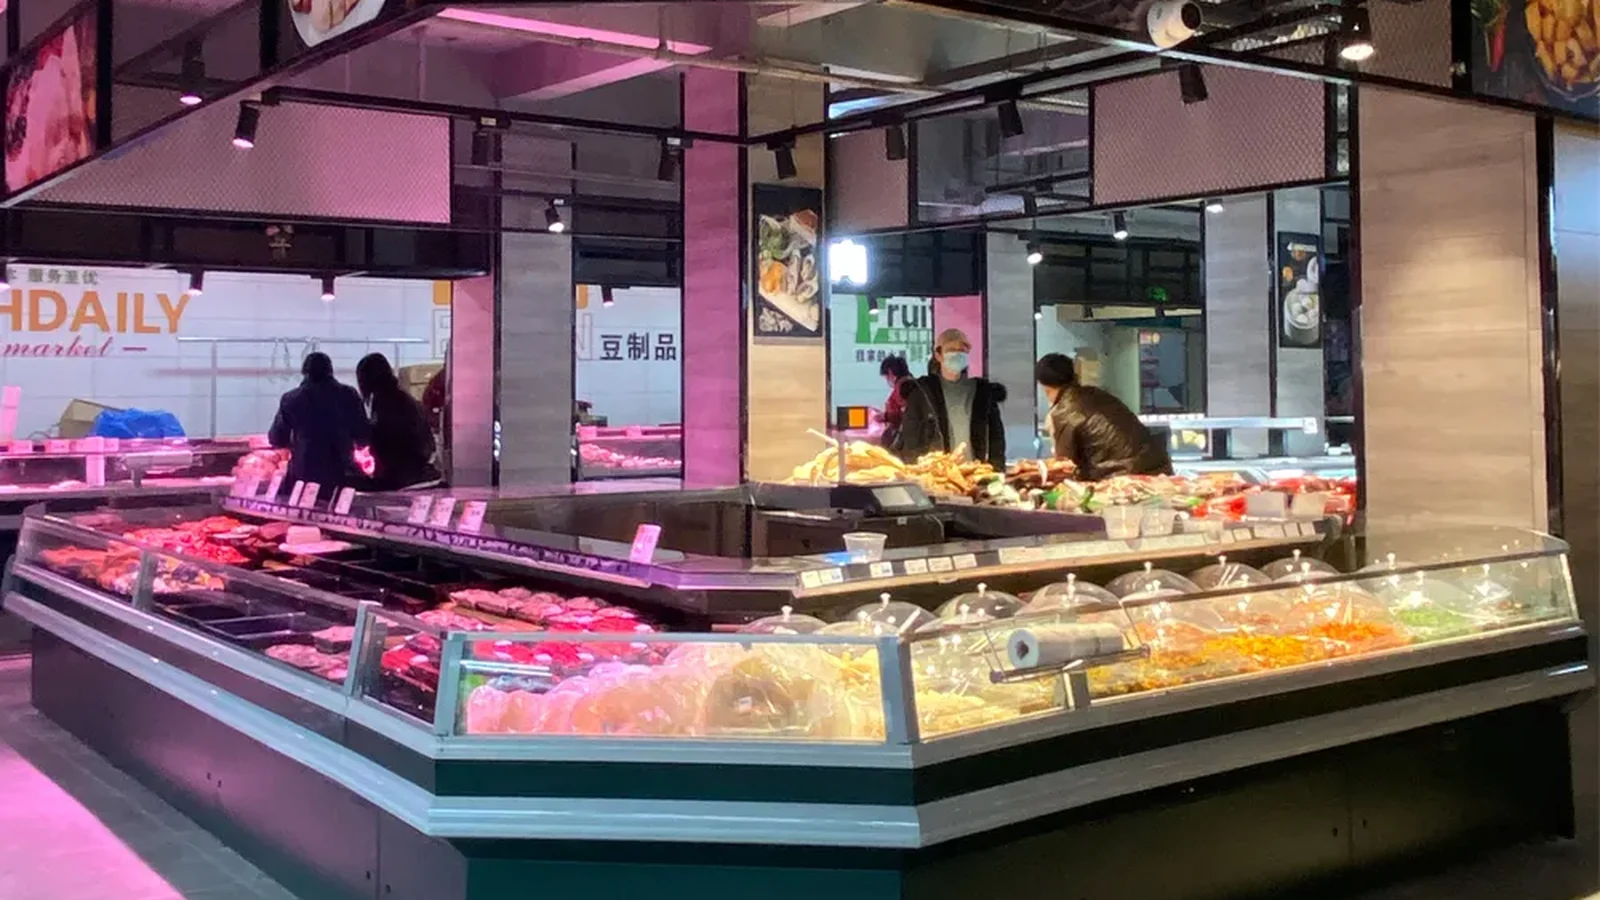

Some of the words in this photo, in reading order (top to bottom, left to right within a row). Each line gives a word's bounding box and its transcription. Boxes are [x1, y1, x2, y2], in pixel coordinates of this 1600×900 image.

[855, 294, 932, 344] Frui
[3, 336, 113, 358] market
[600, 332, 677, 361] 豆制品
